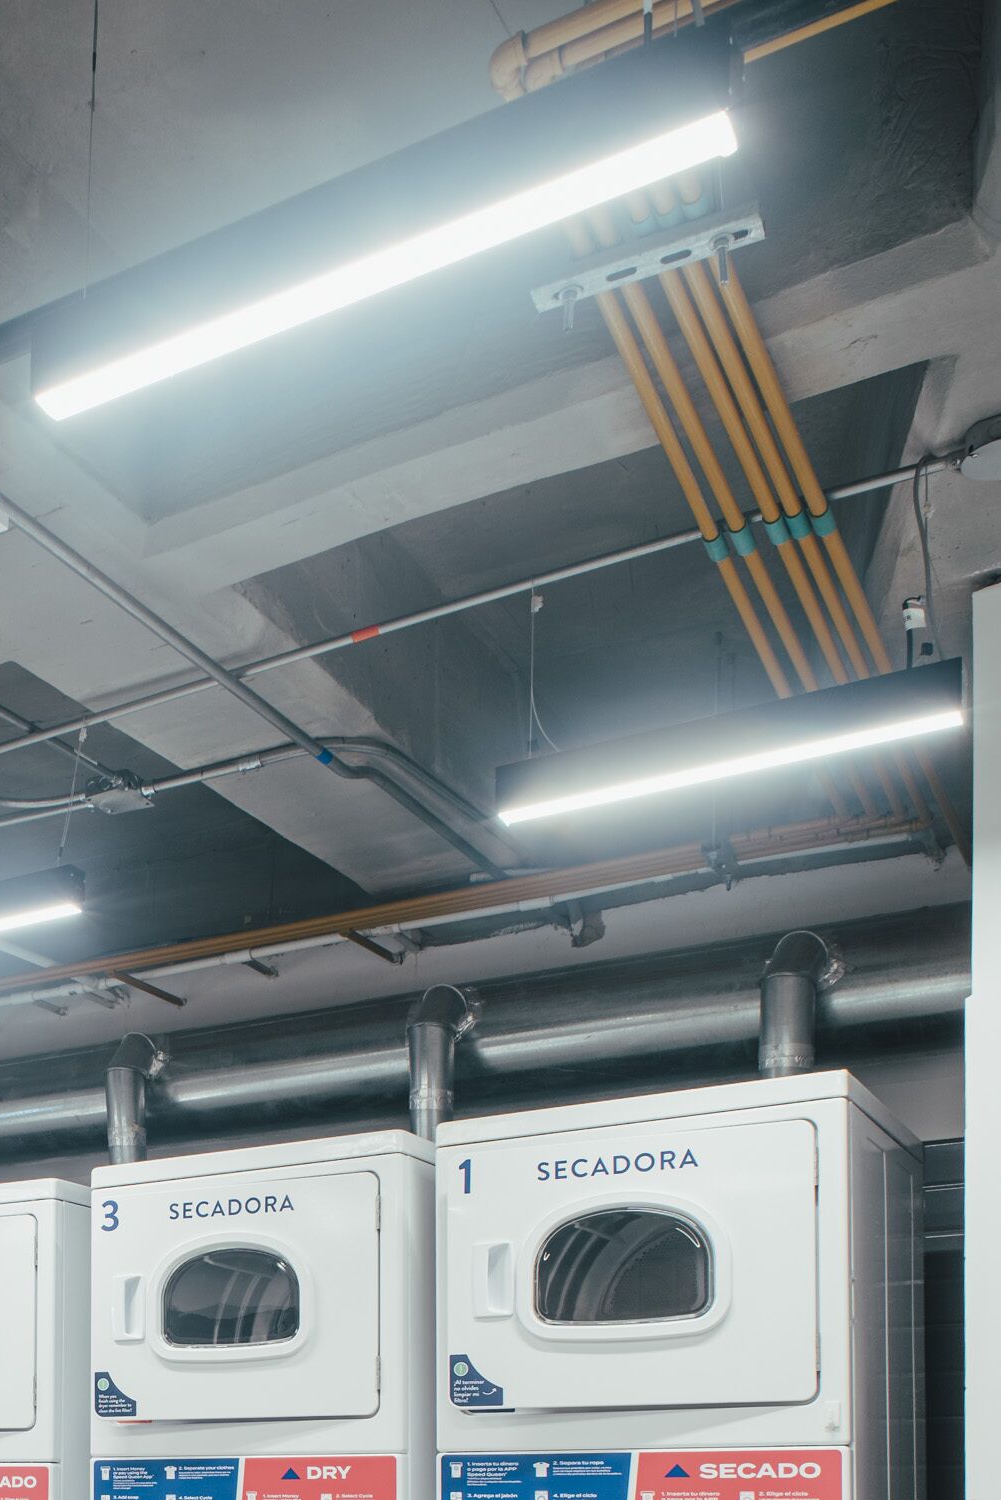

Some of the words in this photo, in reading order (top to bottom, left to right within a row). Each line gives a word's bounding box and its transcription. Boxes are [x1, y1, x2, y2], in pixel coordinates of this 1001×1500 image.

[458, 1158, 472, 1194] 1
[537, 1148, 699, 1182] SECADORA
[101, 1200, 119, 1232] 3
[169, 1195, 295, 1220] SECADORA
[307, 1465, 352, 1480] DRY
[699, 1462, 822, 1480] SECADO
